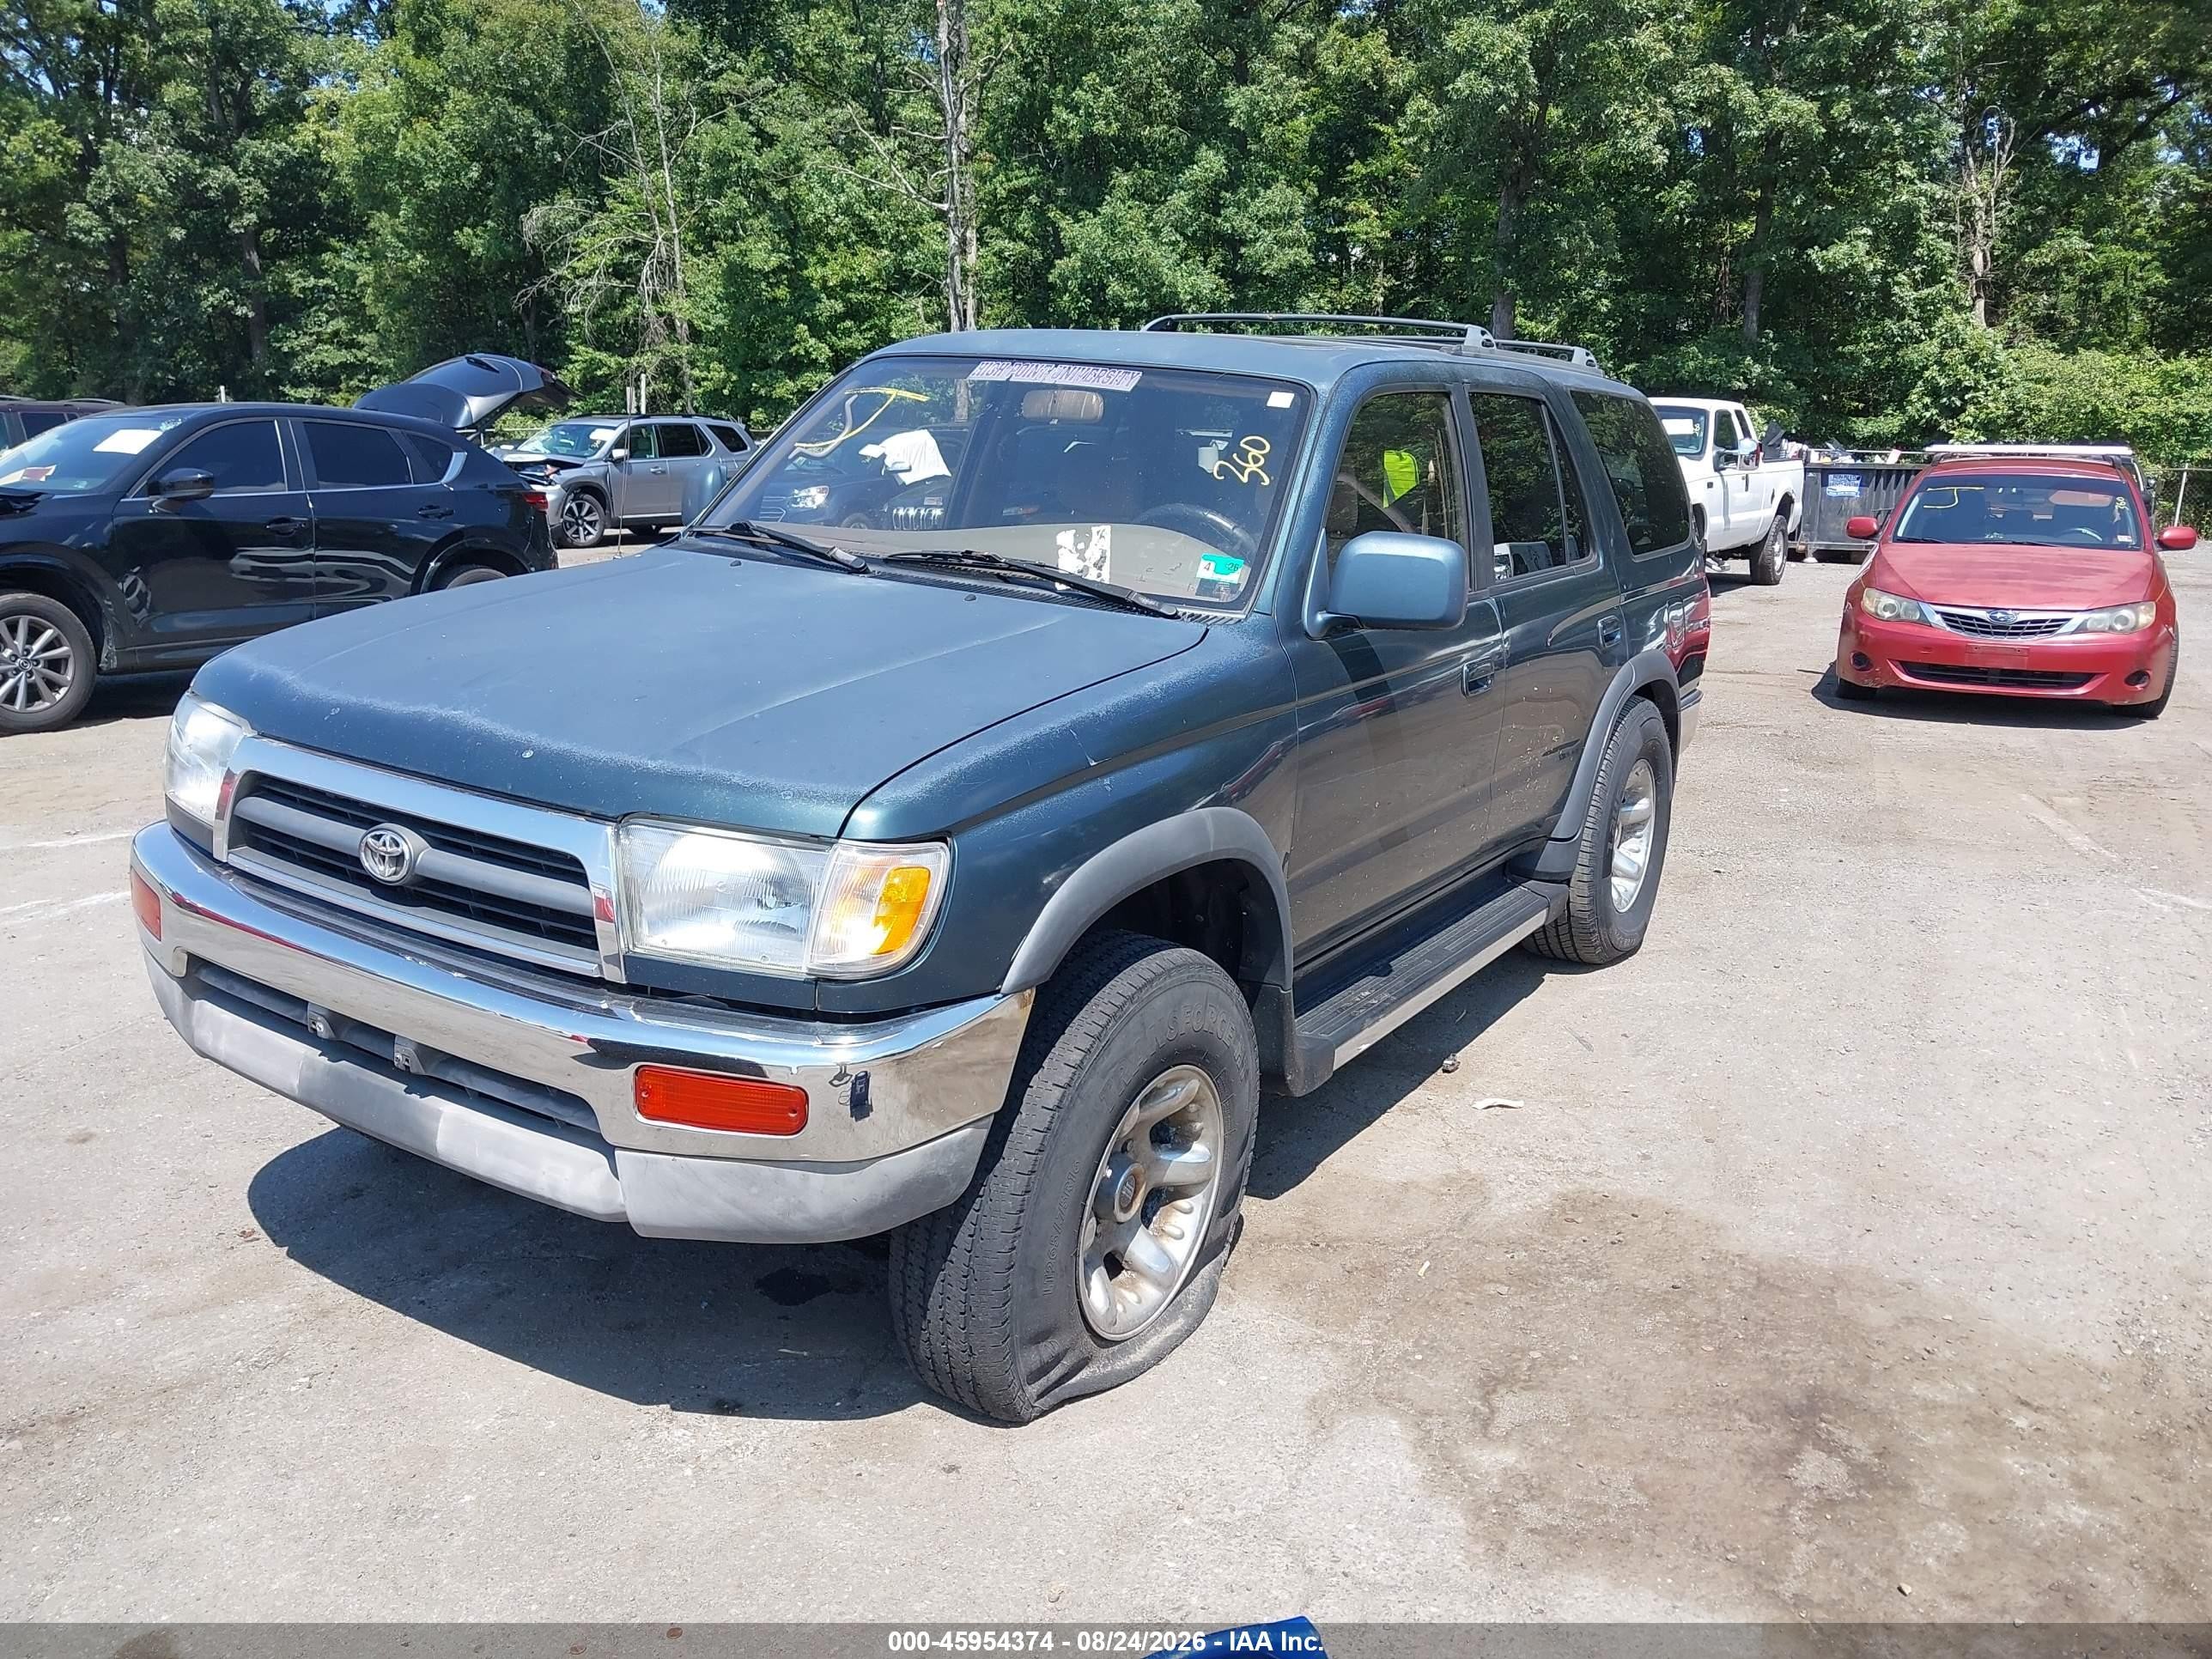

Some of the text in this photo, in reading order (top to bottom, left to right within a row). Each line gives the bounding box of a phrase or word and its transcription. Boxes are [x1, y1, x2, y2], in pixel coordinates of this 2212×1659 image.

[973, 362, 1140, 388] HIGH POINT UNIVERSITY
[1212, 435, 1271, 486] 360
[1204, 562, 1212, 571] 4
